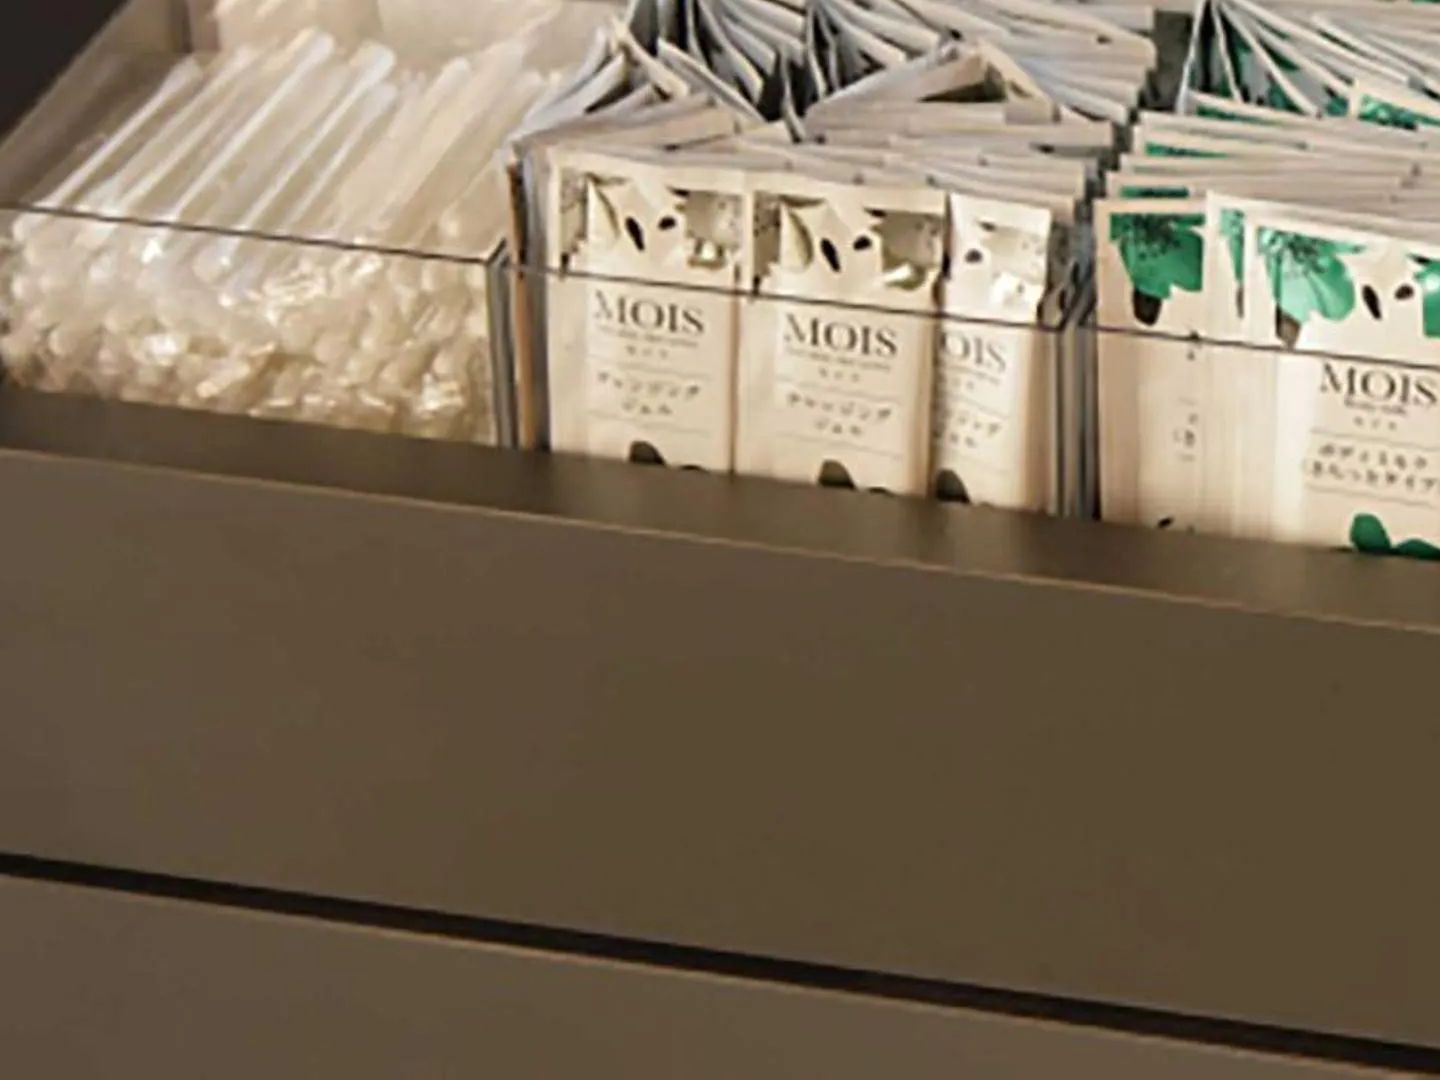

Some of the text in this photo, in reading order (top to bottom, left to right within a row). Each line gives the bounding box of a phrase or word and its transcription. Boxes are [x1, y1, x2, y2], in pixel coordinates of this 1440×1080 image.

[594, 287, 705, 336] MOIS
[784, 311, 898, 358] MOIS
[1319, 362, 1438, 410] MOIS
